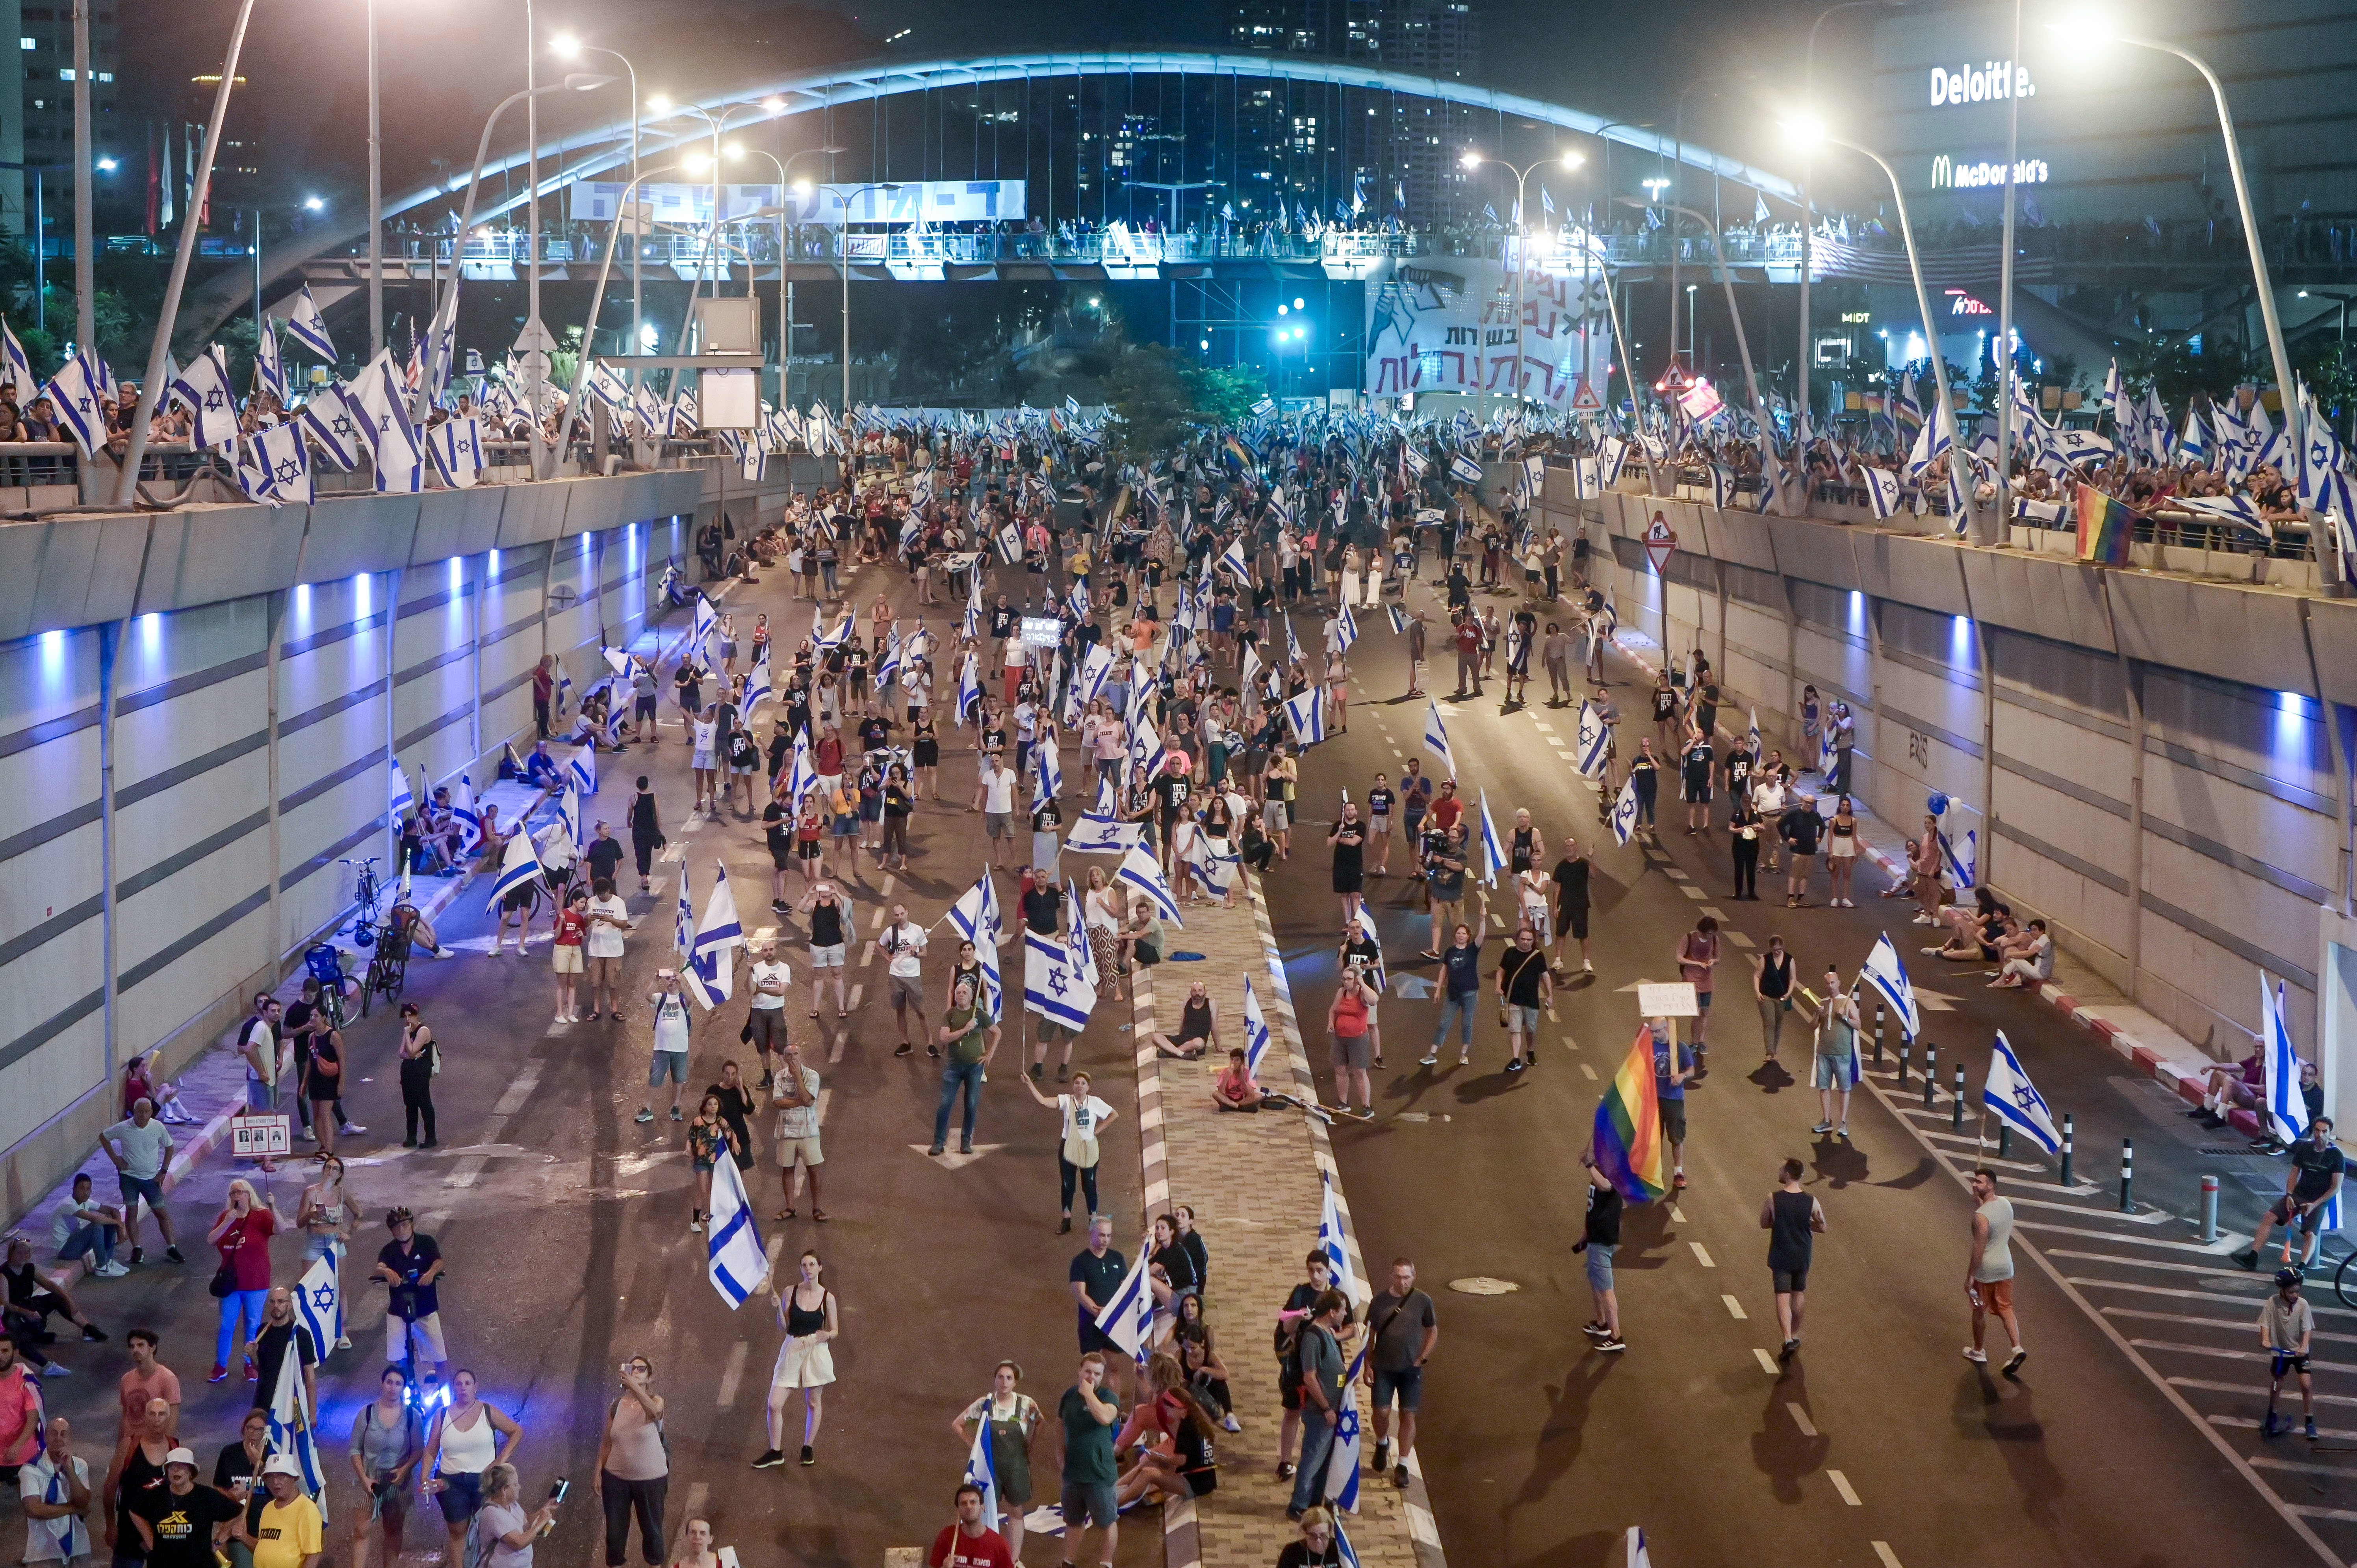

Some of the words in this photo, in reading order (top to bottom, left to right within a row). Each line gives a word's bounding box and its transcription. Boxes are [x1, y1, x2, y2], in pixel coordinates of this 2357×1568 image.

[1734, 769, 1747, 777] קרט
[1173, 791, 1186, 801] קרט
[1043, 813, 1055, 821] דמו
